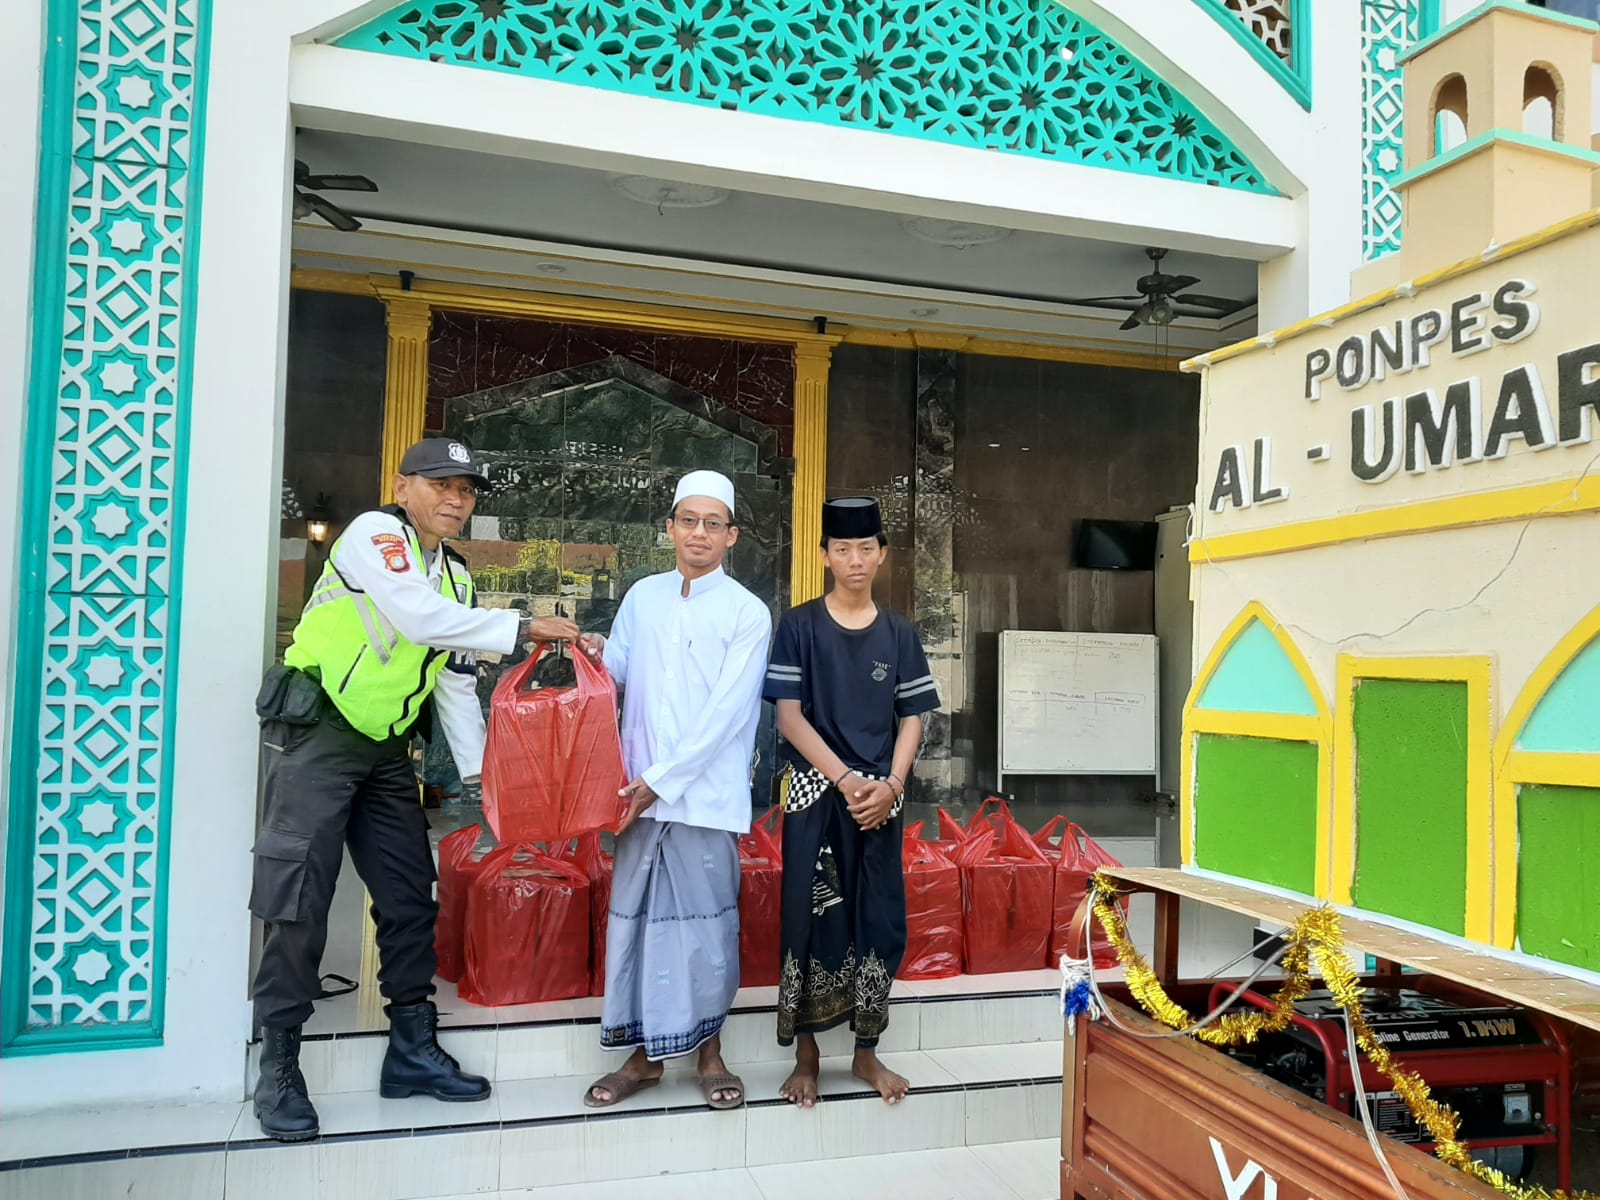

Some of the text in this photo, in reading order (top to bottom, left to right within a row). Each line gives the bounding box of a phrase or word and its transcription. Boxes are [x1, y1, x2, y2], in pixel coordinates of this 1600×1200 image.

[1304, 279, 1541, 401] PONPES
[1209, 436, 1290, 513] AL
[1350, 342, 1600, 484] UMAR
[1402, 1029, 1450, 1042] Generator
